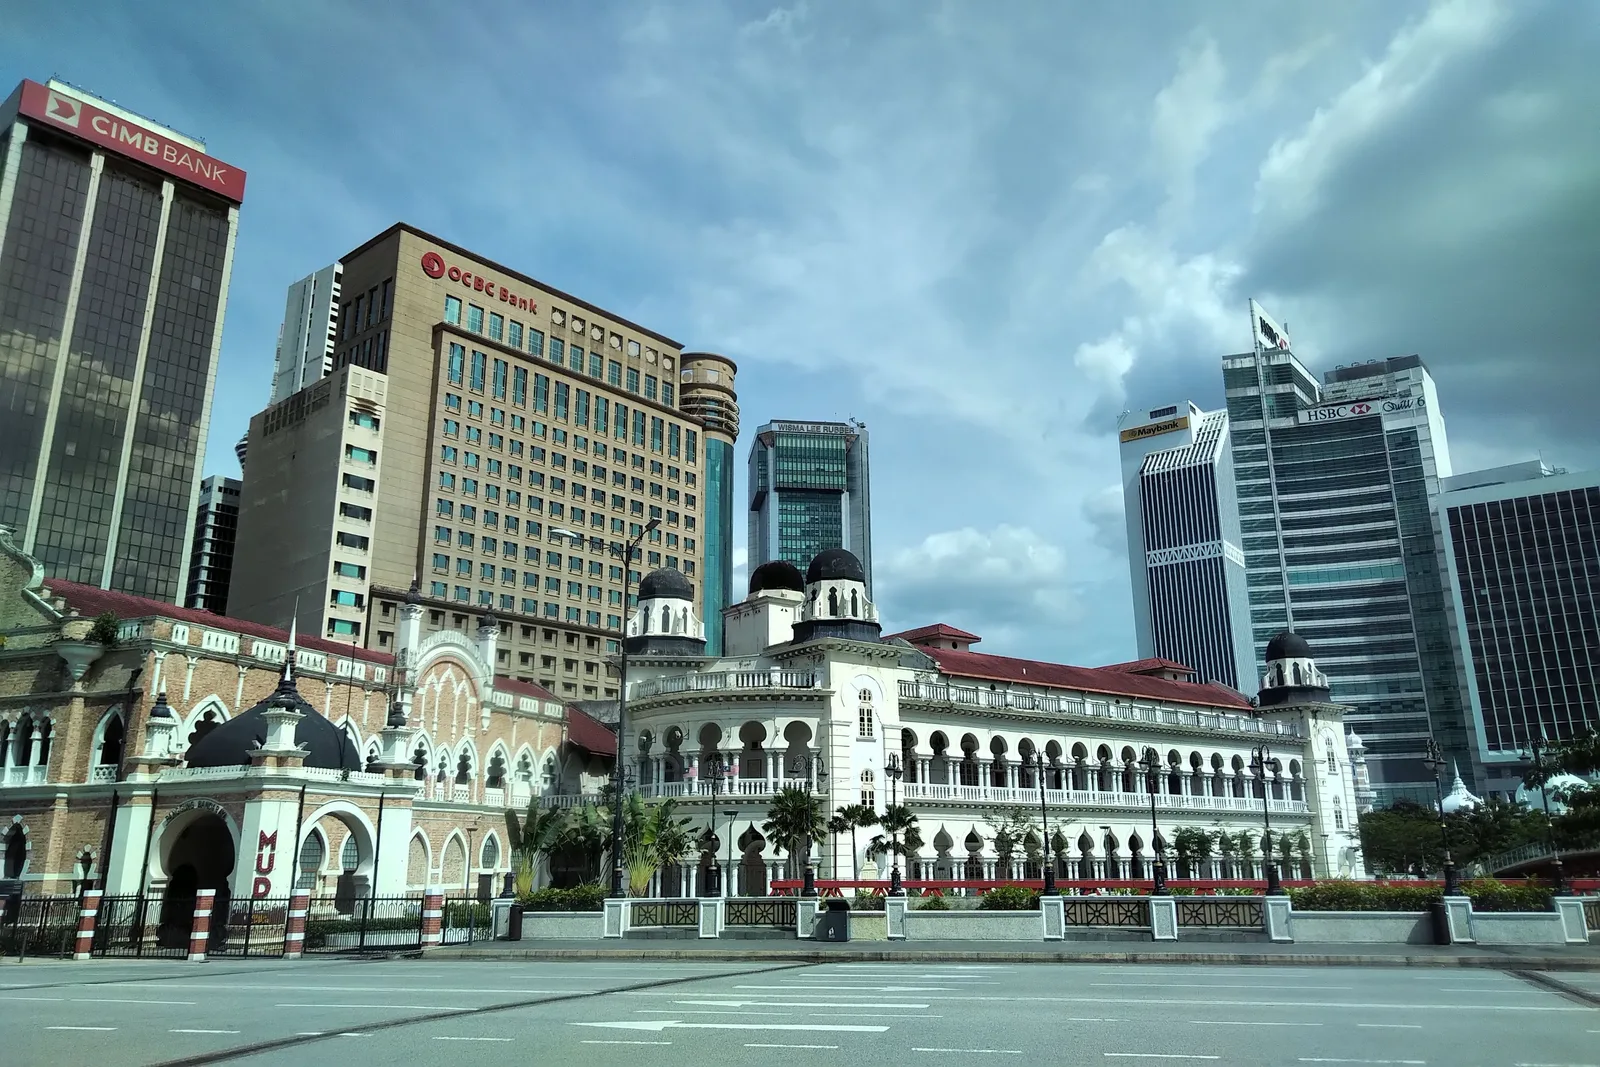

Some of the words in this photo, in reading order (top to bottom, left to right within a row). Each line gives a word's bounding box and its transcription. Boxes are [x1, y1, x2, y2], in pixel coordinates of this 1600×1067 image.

[91, 116, 159, 156] CIMB
[163, 144, 227, 185] BANK
[448, 265, 496, 297] OCBC
[499, 286, 538, 315] Bank
[1382, 400, 1414, 412] Quill
[1417, 396, 1426, 407] 6
[1307, 406, 1347, 421] HSBC
[778, 423, 805, 432] WISMA
[806, 425, 821, 433] LEE
[823, 425, 855, 434] RUBBER
[1137, 421, 1179, 436] Maybank
[253, 829, 278, 898] MUD
